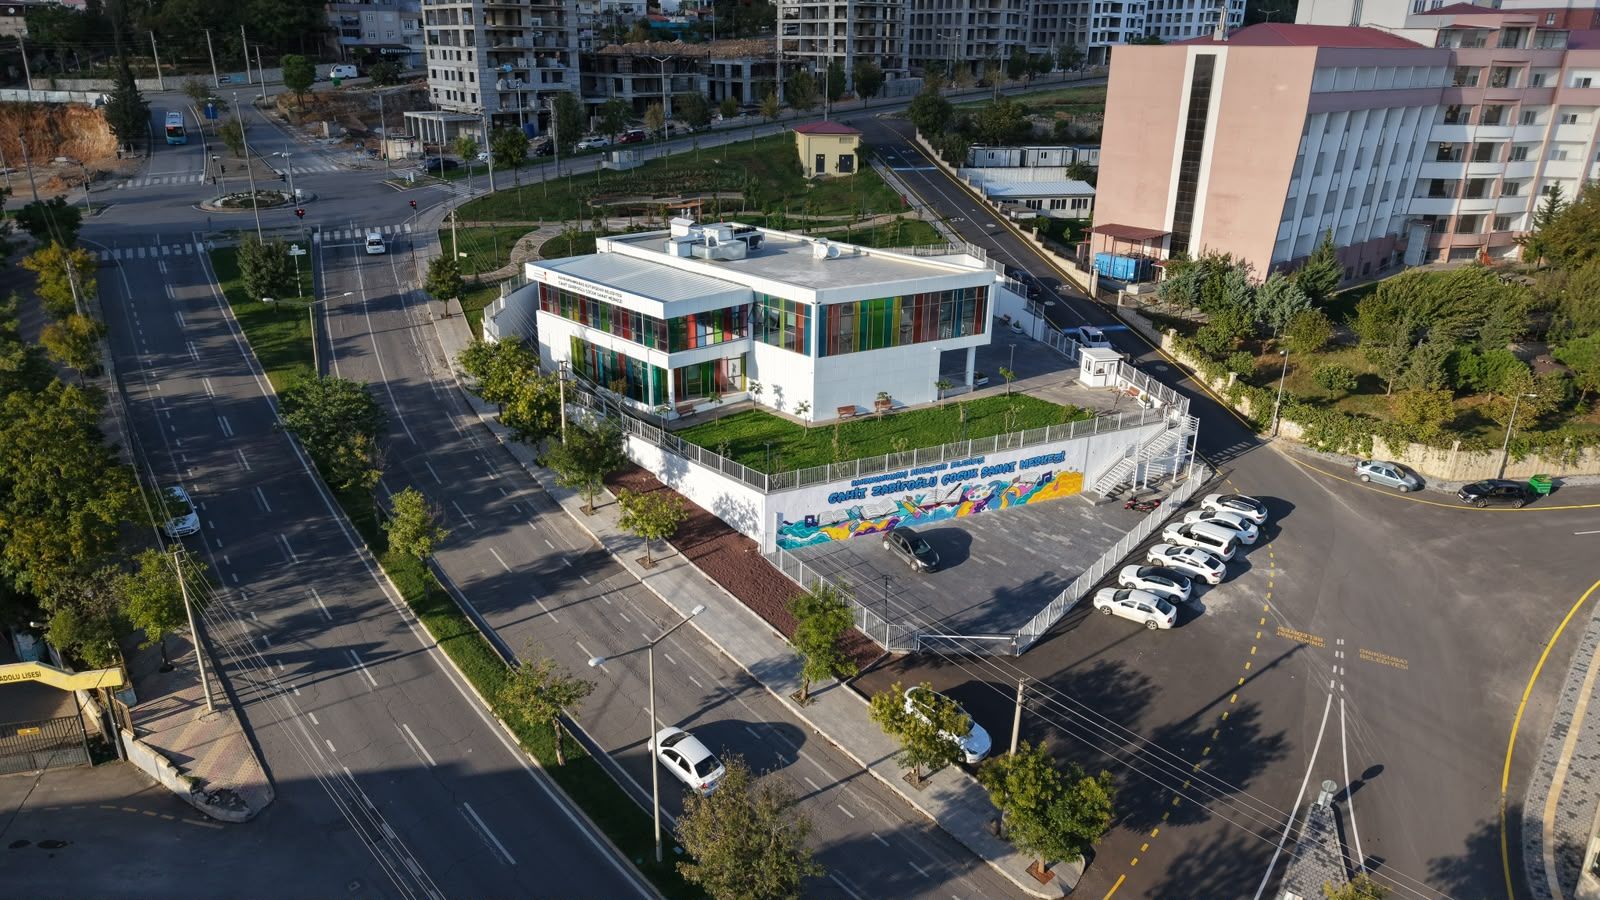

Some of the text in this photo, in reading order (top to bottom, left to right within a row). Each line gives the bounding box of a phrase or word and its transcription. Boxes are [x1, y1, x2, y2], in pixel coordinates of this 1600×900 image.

[828, 450, 1066, 504] CAHİT ZARİFOĞLU ÇOCUK SANAT MERKEZİ
